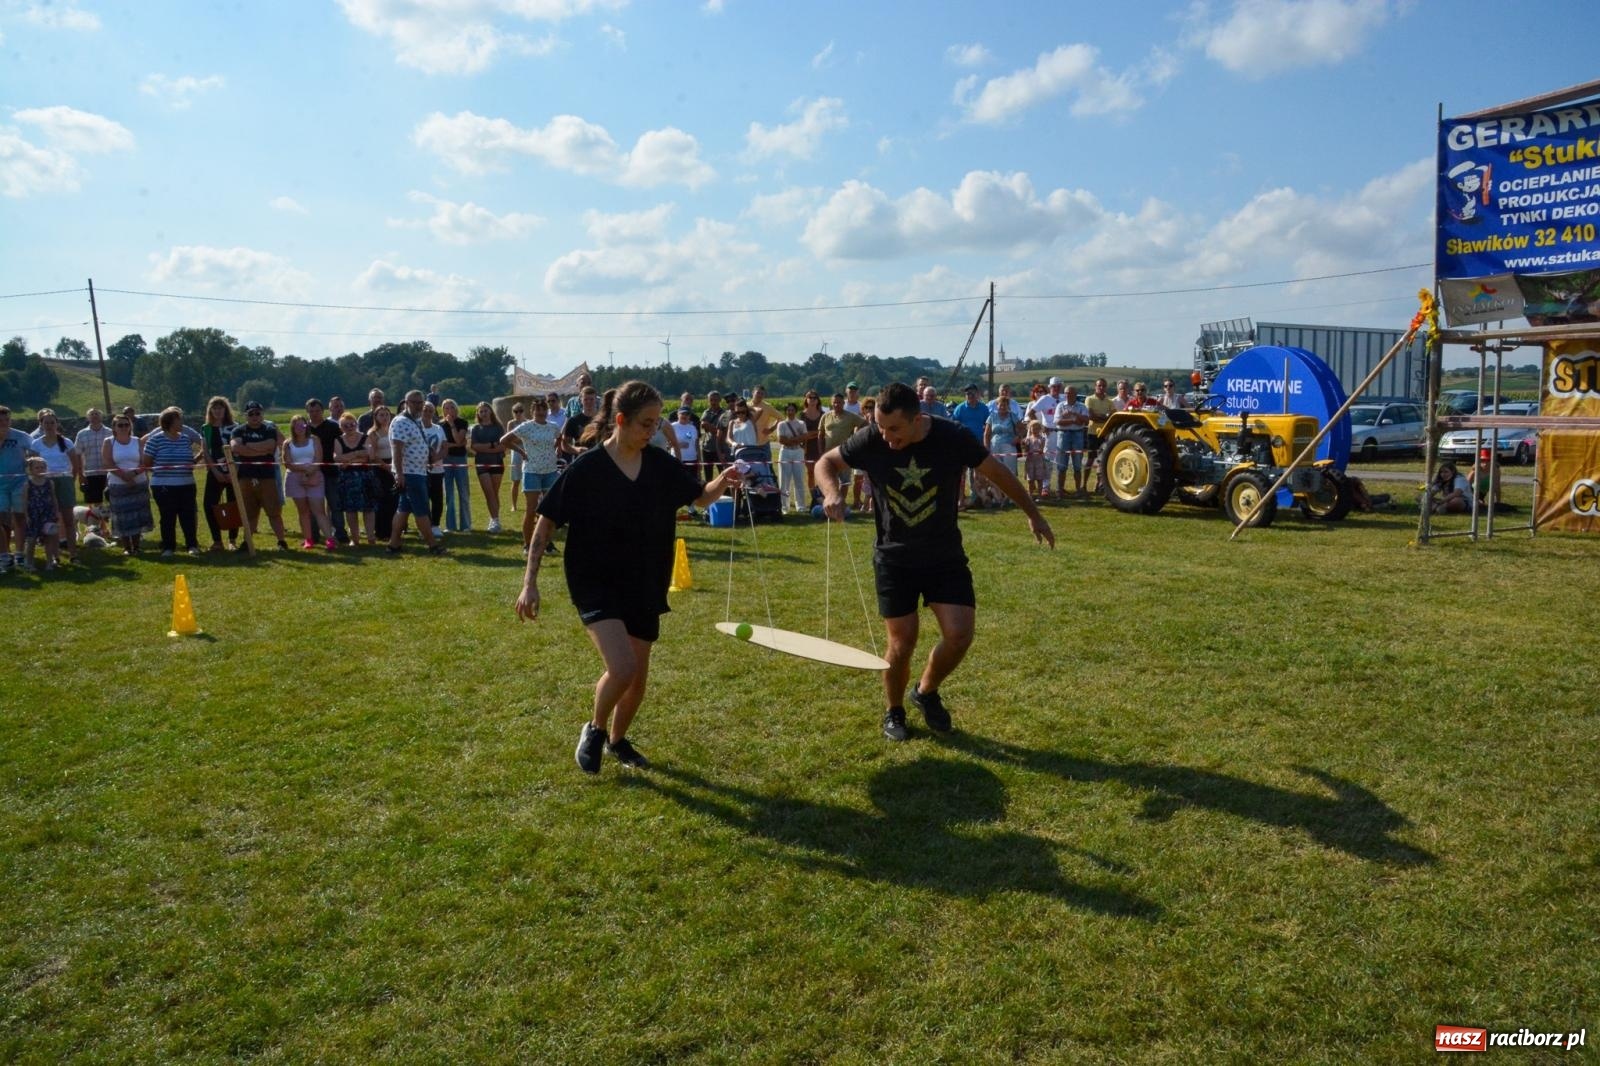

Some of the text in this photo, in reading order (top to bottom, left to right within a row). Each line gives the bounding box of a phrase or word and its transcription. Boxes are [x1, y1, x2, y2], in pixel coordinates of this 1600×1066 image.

[1498, 165, 1600, 193] OCIEPLANIE
[1498, 183, 1600, 209] PRODUKCJA
[1500, 209, 1547, 226] TYNKI
[1446, 224, 1595, 255] Sławików 32 410
[1504, 249, 1600, 269] www.sztuka
[1227, 378, 1302, 394] KREATYWNE
[1226, 394, 1259, 409] studio
